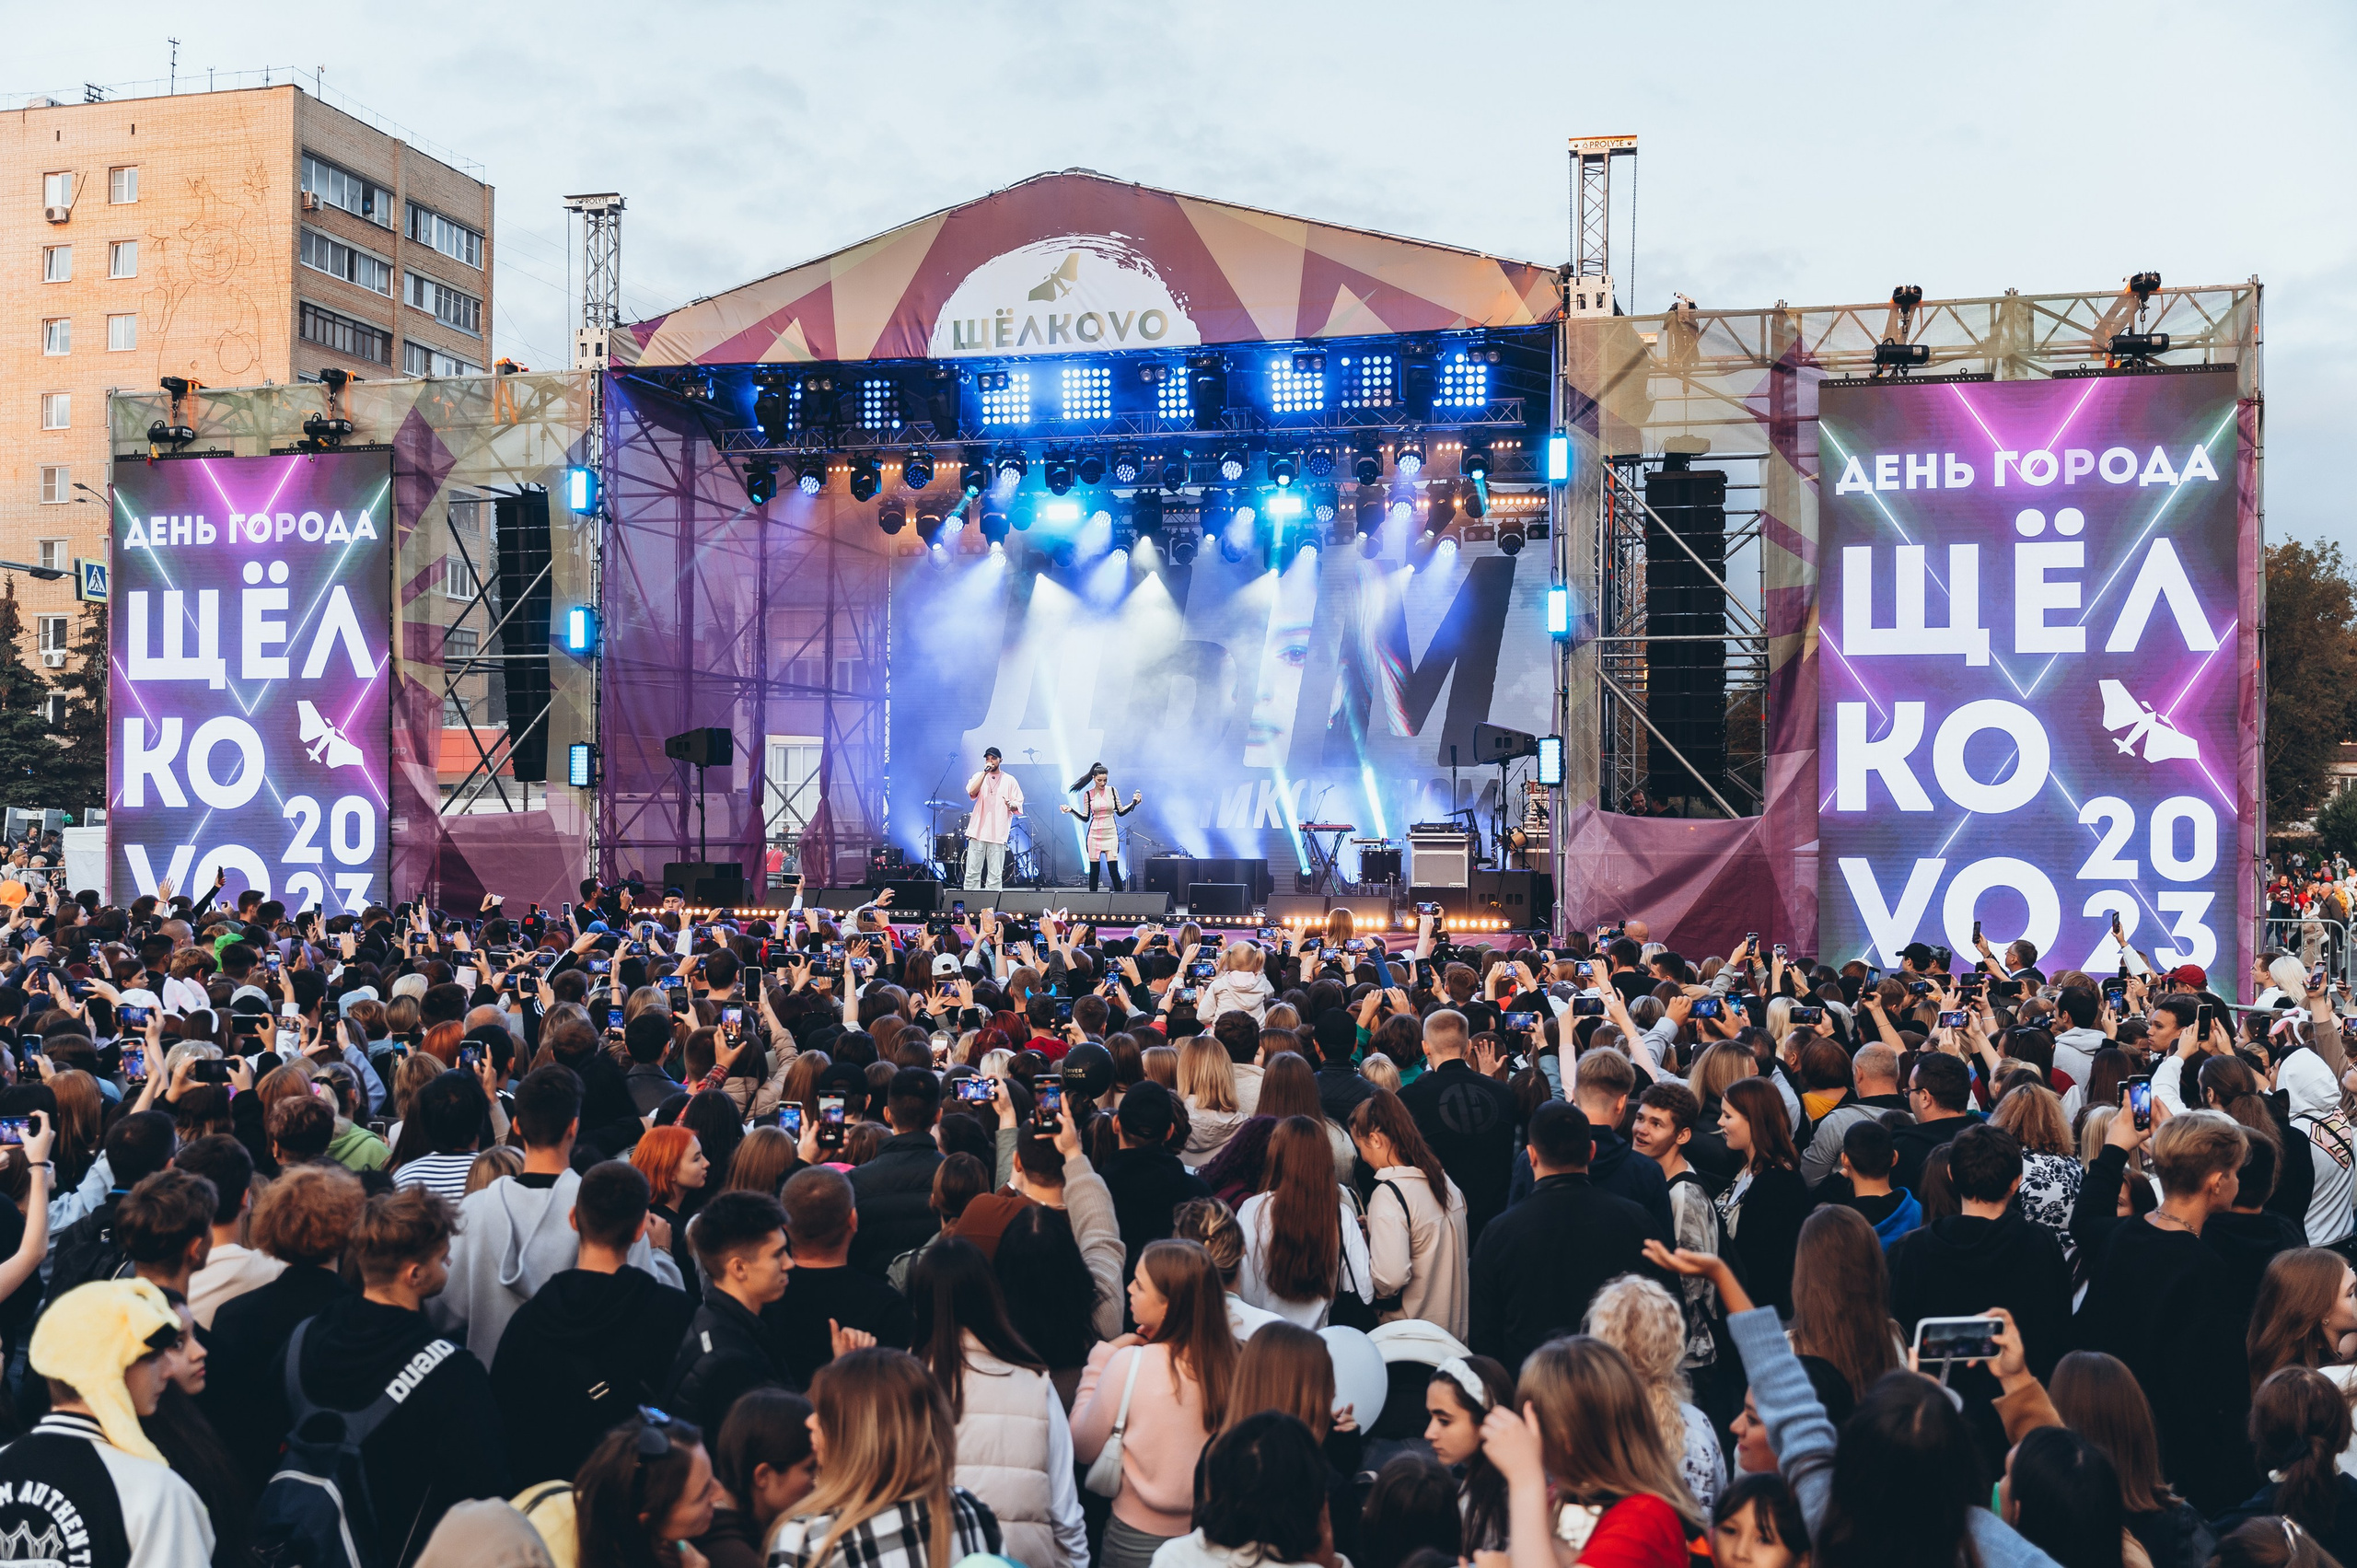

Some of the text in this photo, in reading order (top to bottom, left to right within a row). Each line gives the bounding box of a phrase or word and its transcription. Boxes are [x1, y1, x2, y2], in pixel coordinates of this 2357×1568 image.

[1589, 139, 1624, 148] PROLYTE
[582, 196, 609, 204] PROLYTE
[1835, 444, 2220, 495] ДЕНЬ ГОРОДА
[123, 509, 378, 551] ДЕНЬ ГОРОДА
[128, 560, 377, 690] ЩЁЛ
[1842, 507, 2220, 667] ЩЁЛ
[123, 715, 265, 809] КО
[1836, 698, 2050, 814] КО
[282, 795, 376, 865] 20
[2075, 796, 2218, 882] 20
[284, 870, 374, 921] 23
[2080, 889, 2217, 972] 23
[385, 1339, 456, 1405] arena
[17, 1479, 92, 1568] AUTHENT
